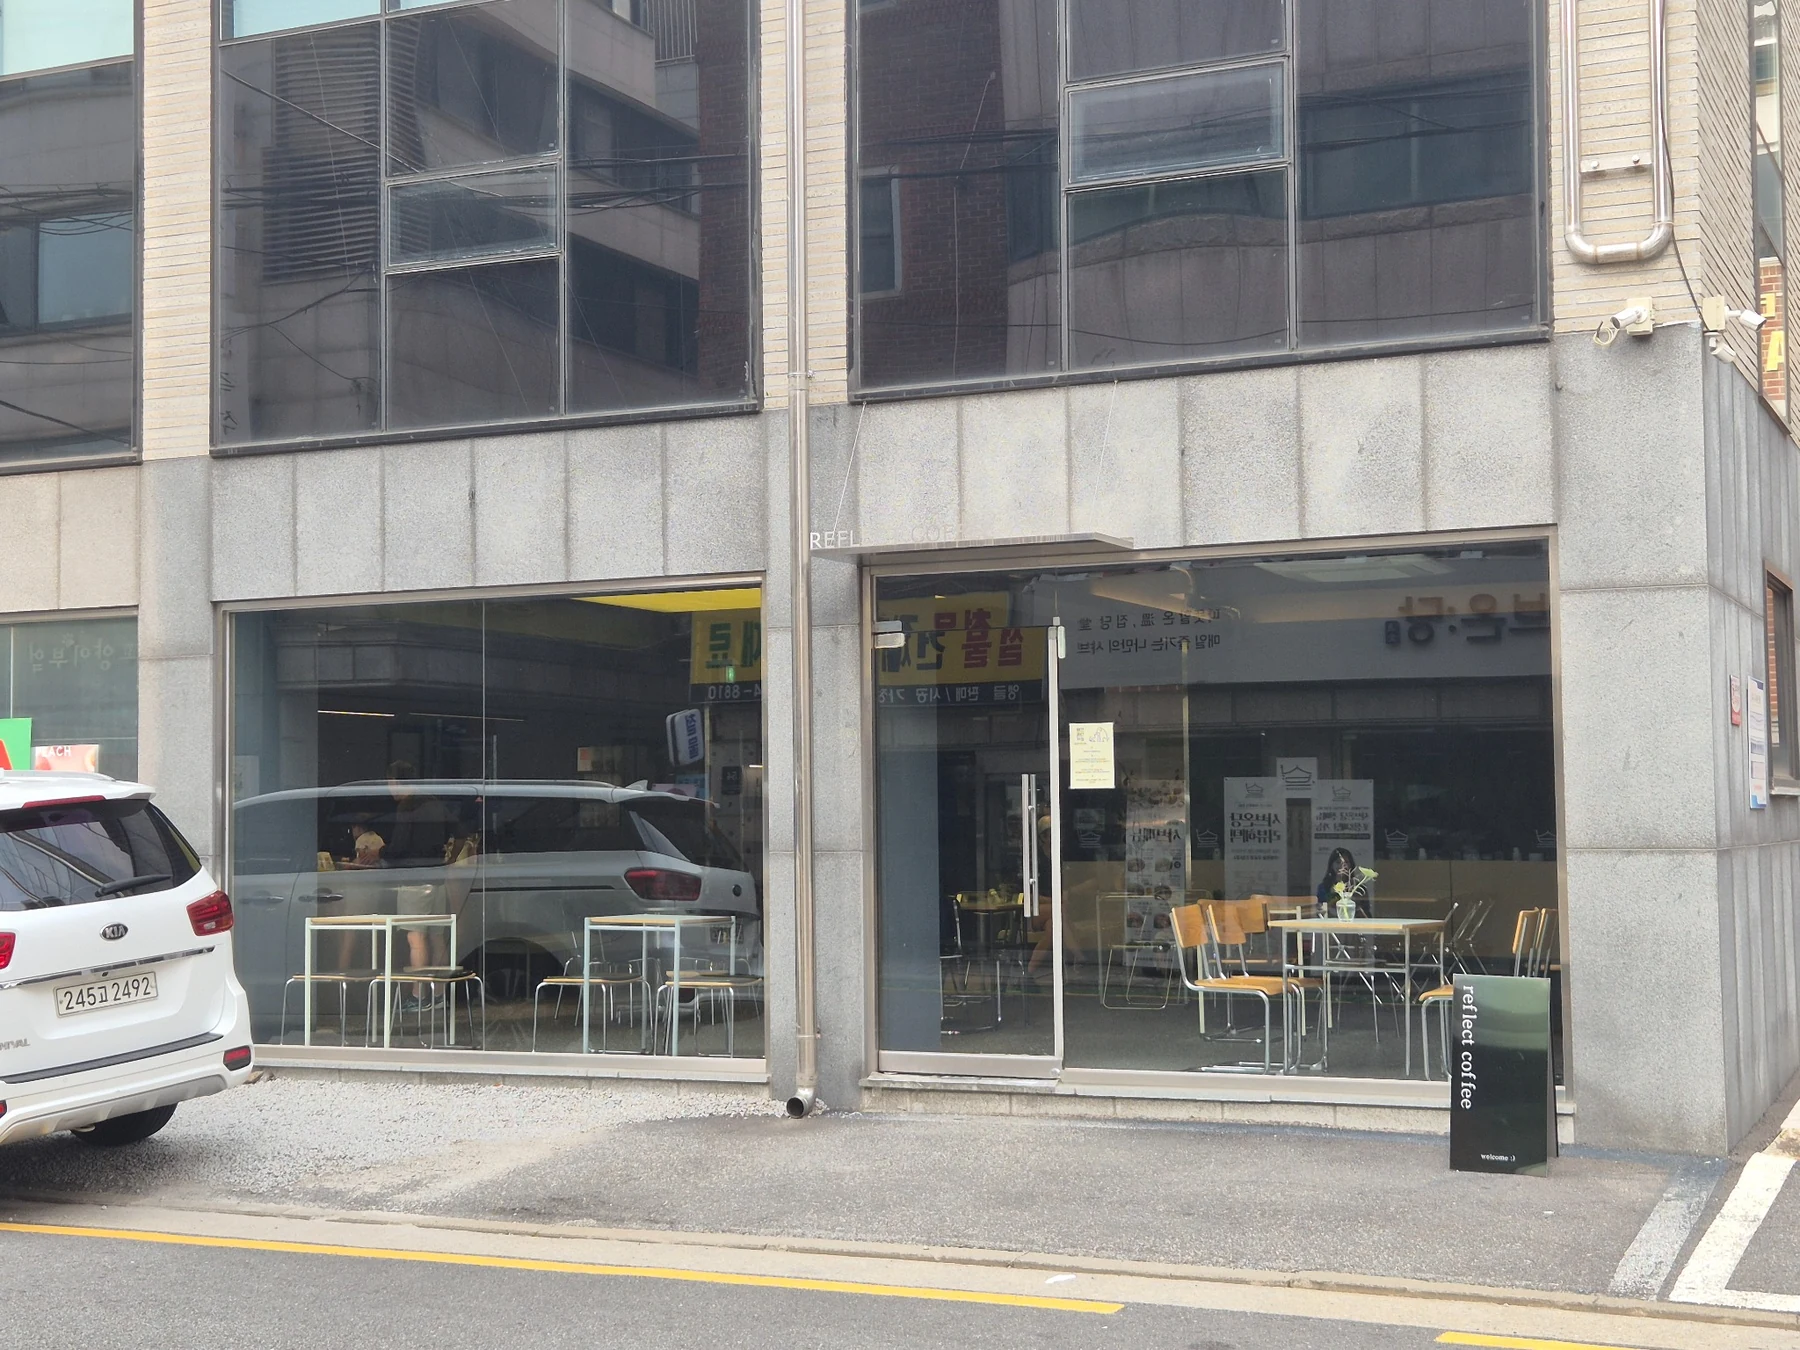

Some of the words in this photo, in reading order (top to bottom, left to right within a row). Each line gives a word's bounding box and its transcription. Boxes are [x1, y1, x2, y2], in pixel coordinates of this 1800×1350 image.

[1460, 985, 1478, 1046] reflect
[1460, 1051, 1477, 1110] coffee
[1480, 1153, 1509, 1162] welcome
